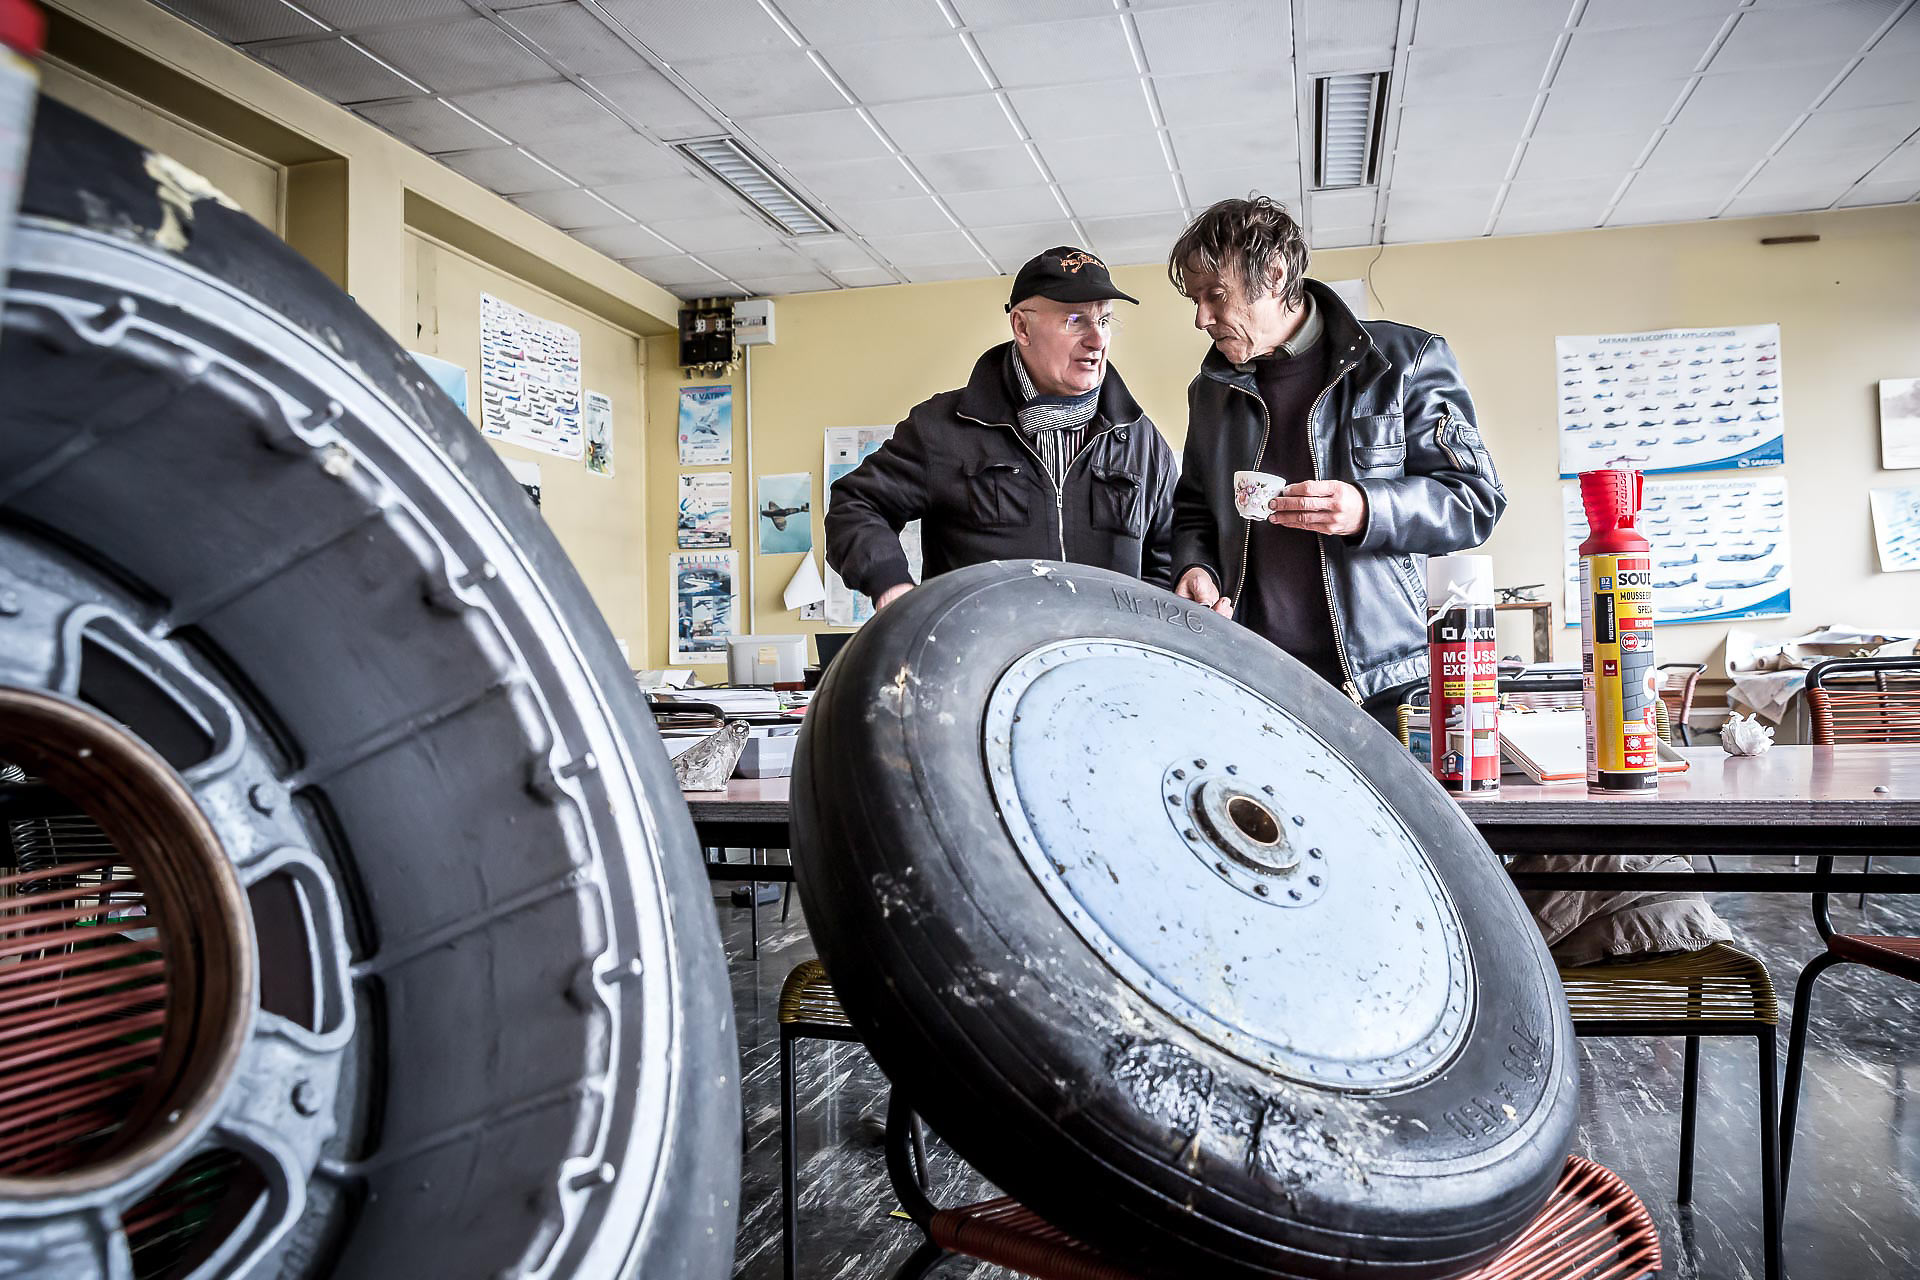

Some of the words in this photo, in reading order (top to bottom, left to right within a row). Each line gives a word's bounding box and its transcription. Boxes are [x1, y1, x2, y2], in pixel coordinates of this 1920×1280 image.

[1630, 333, 1679, 343] HELICOPTER
[1680, 331, 1736, 340] APPLICATIONS
[1112, 587, 1142, 615] Nr
[1151, 596, 1204, 635] 126
